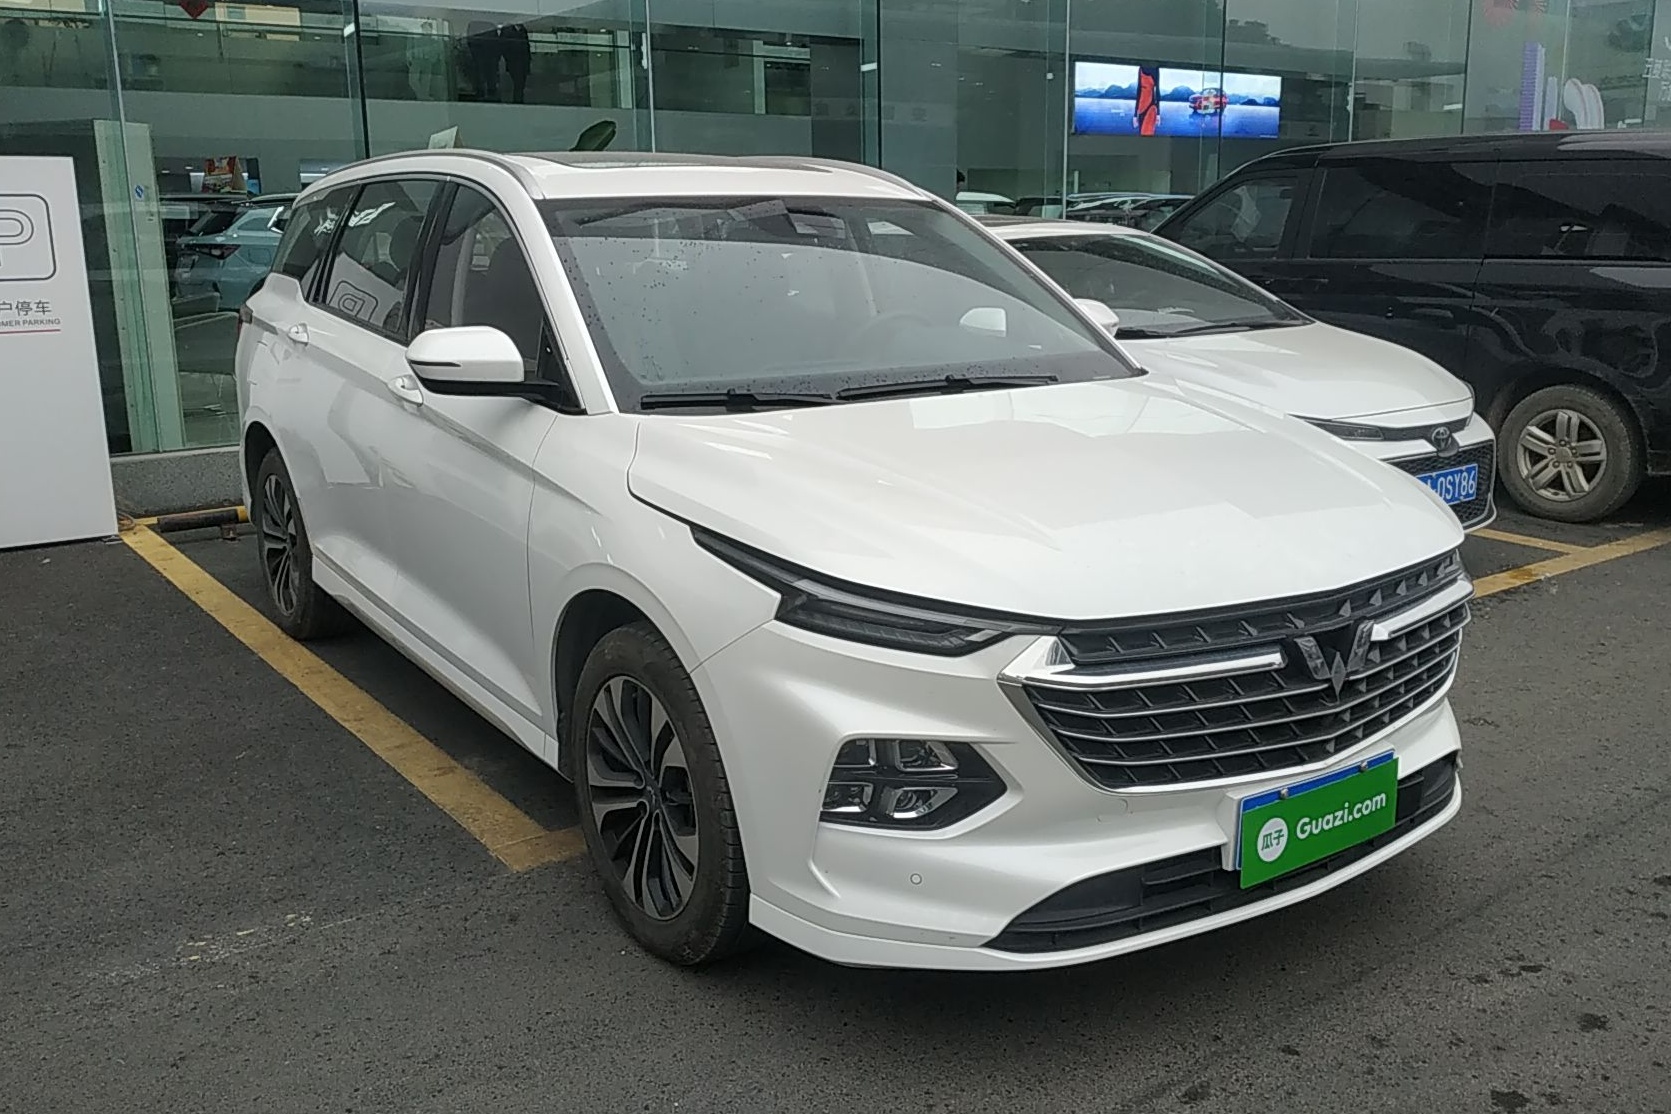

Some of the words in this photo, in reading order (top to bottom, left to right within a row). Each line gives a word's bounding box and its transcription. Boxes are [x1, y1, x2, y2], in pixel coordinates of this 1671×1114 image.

[22, 318, 61, 326] PARKING
[1296, 792, 1386, 840] Guazi.com
[1261, 828, 1285, 851] 瓜子
